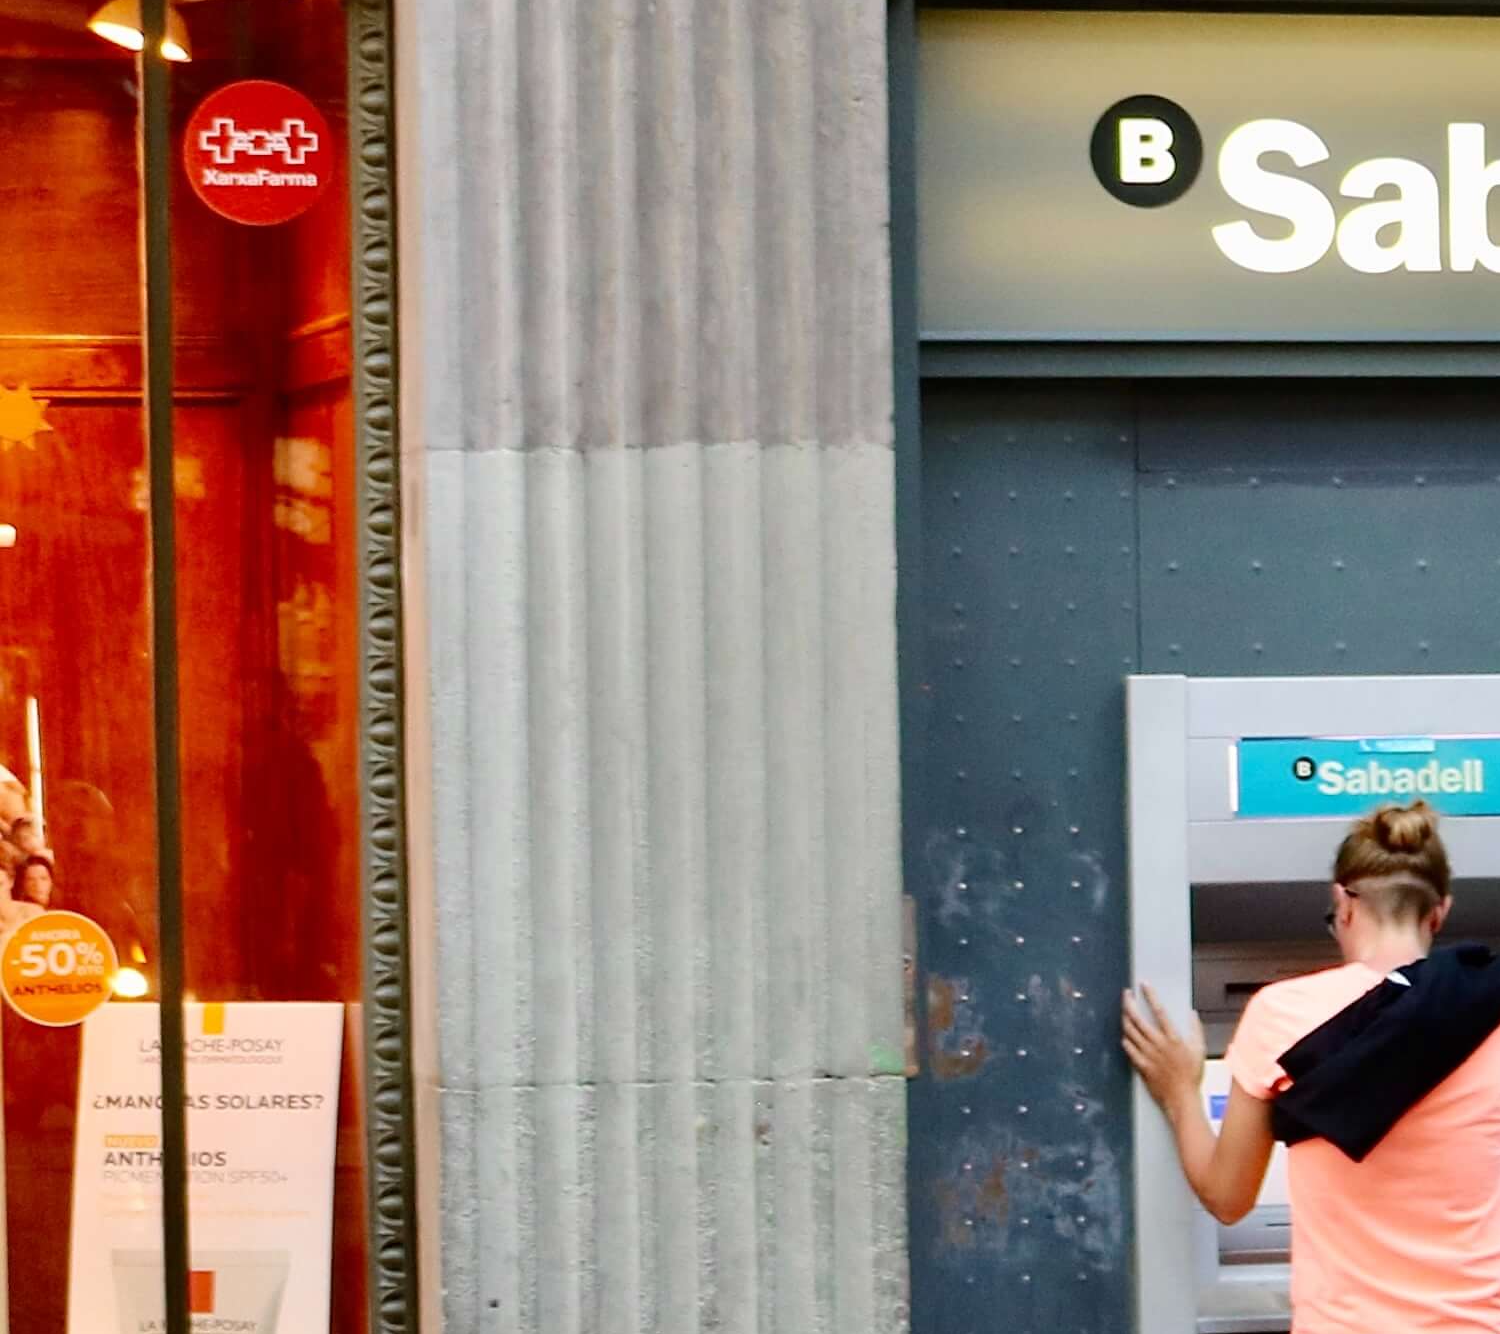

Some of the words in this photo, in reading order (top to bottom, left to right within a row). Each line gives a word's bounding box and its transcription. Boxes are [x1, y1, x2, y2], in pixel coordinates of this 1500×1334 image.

[1317, 759, 1485, 796] Sabadell
[184, 1038, 283, 1053] CHE-POSAY
[93, 1094, 211, 1110] ¿MANCAS
[215, 1093, 324, 1110] SOLARES?
[103, 1151, 227, 1167] ANTHIOS
